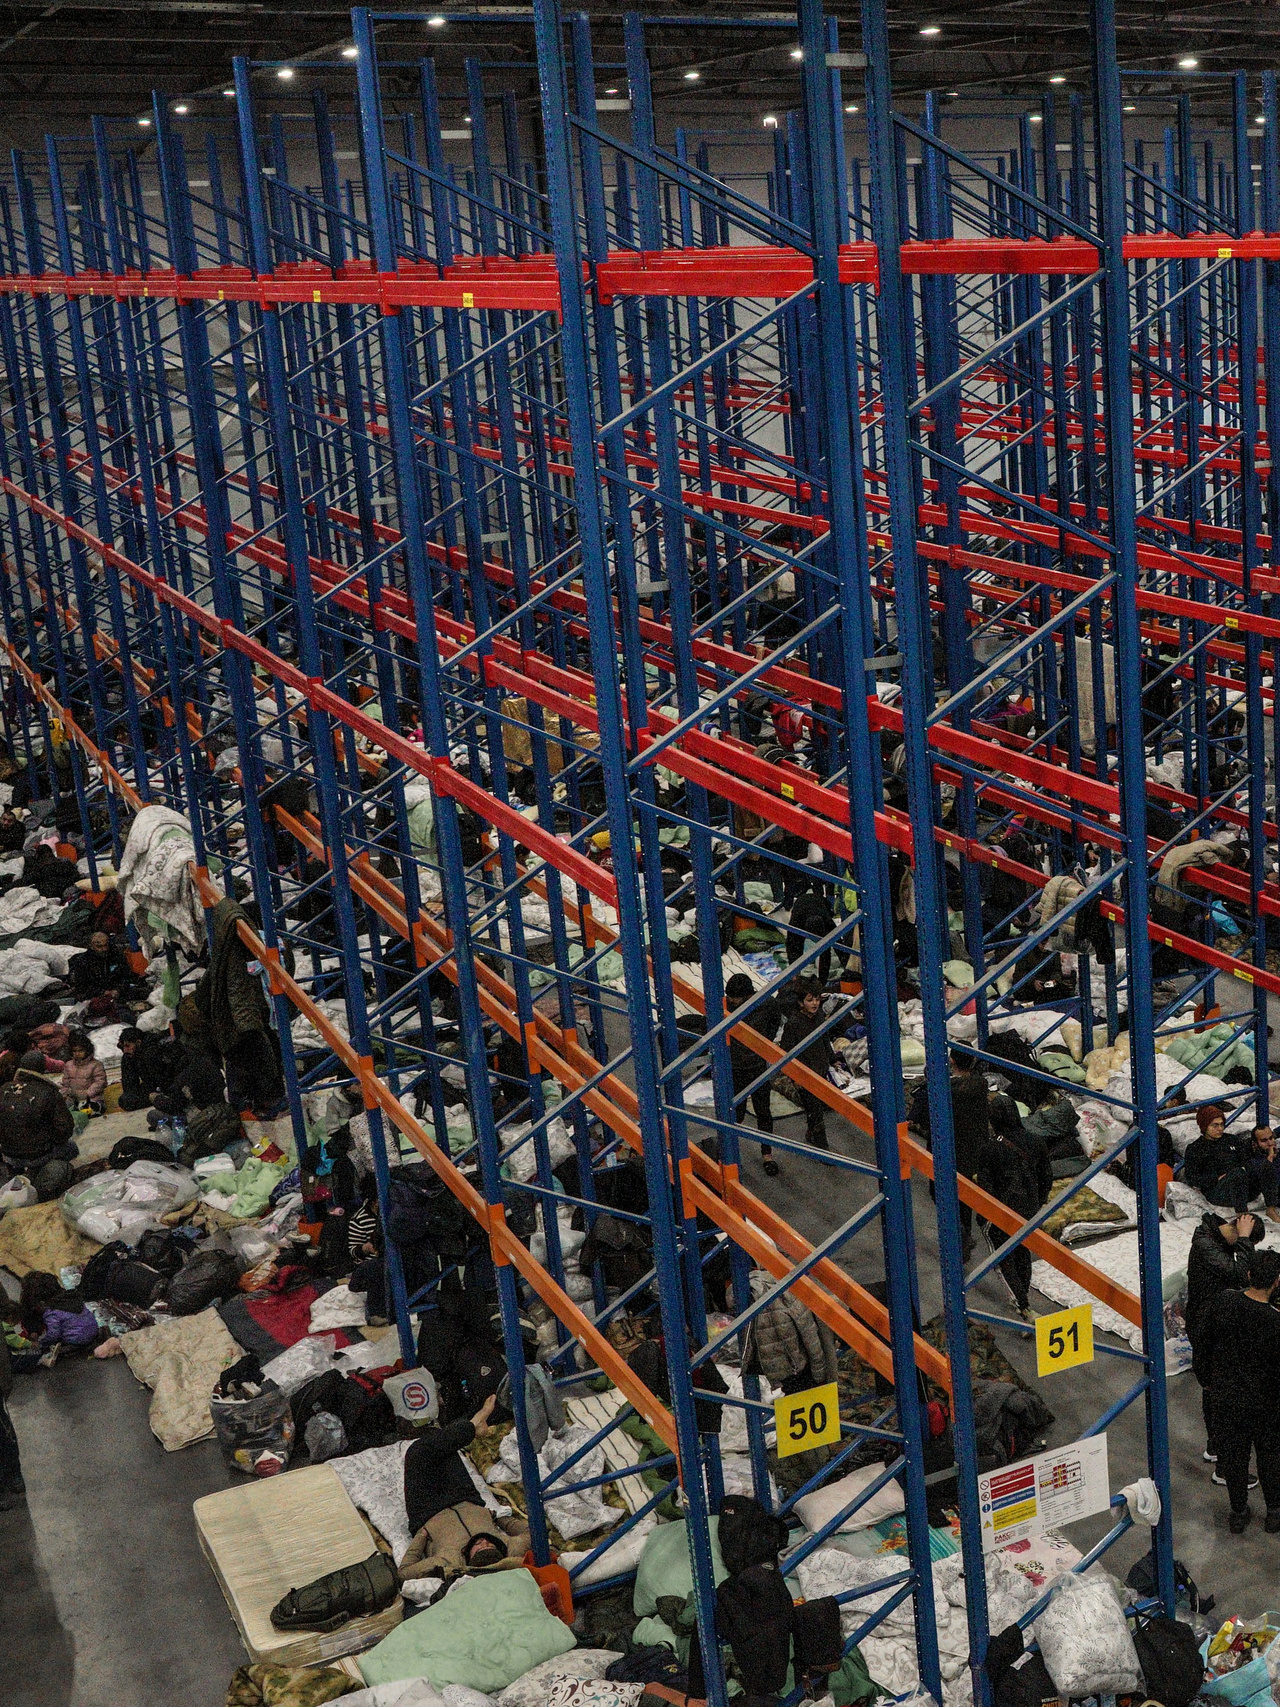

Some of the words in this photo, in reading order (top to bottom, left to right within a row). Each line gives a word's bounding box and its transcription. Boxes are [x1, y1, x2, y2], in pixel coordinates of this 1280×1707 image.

[1048, 1321, 1079, 1359] 51
[406, 1385, 426, 1407] S
[789, 1402, 827, 1441] 50
